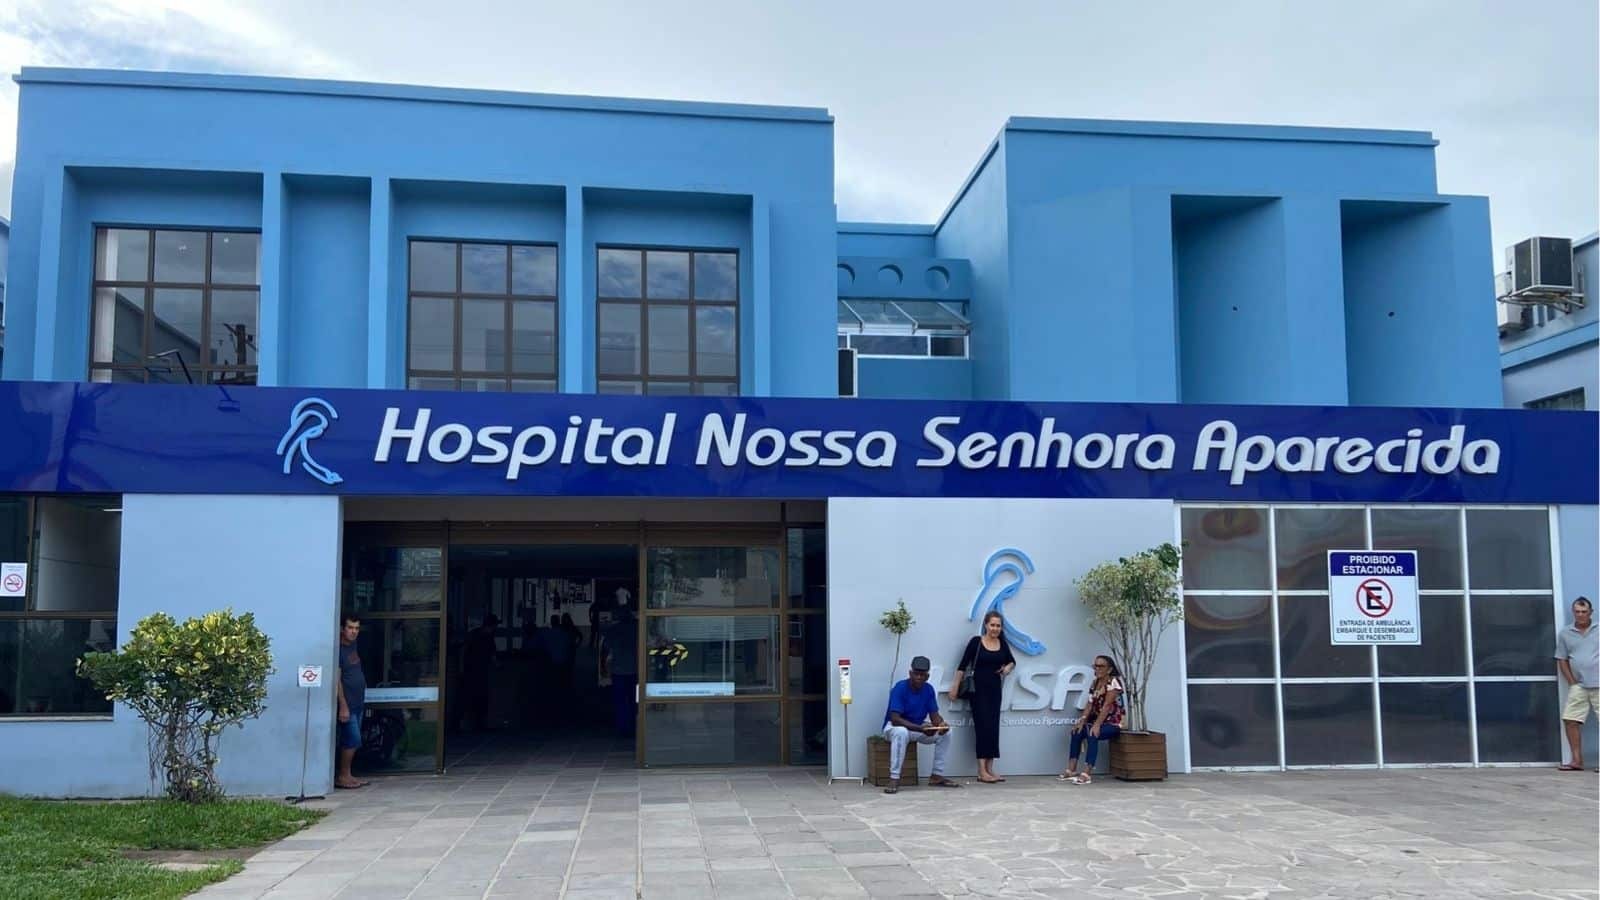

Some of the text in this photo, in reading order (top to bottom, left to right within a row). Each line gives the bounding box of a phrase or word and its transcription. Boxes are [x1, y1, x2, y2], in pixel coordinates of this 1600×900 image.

[374, 407, 1500, 485] Hospital Nossa Senhora Aparecida
[1349, 555, 1396, 564] PROIBIDO
[1342, 566, 1404, 574] ESTACIONAR
[1366, 586, 1383, 610] E
